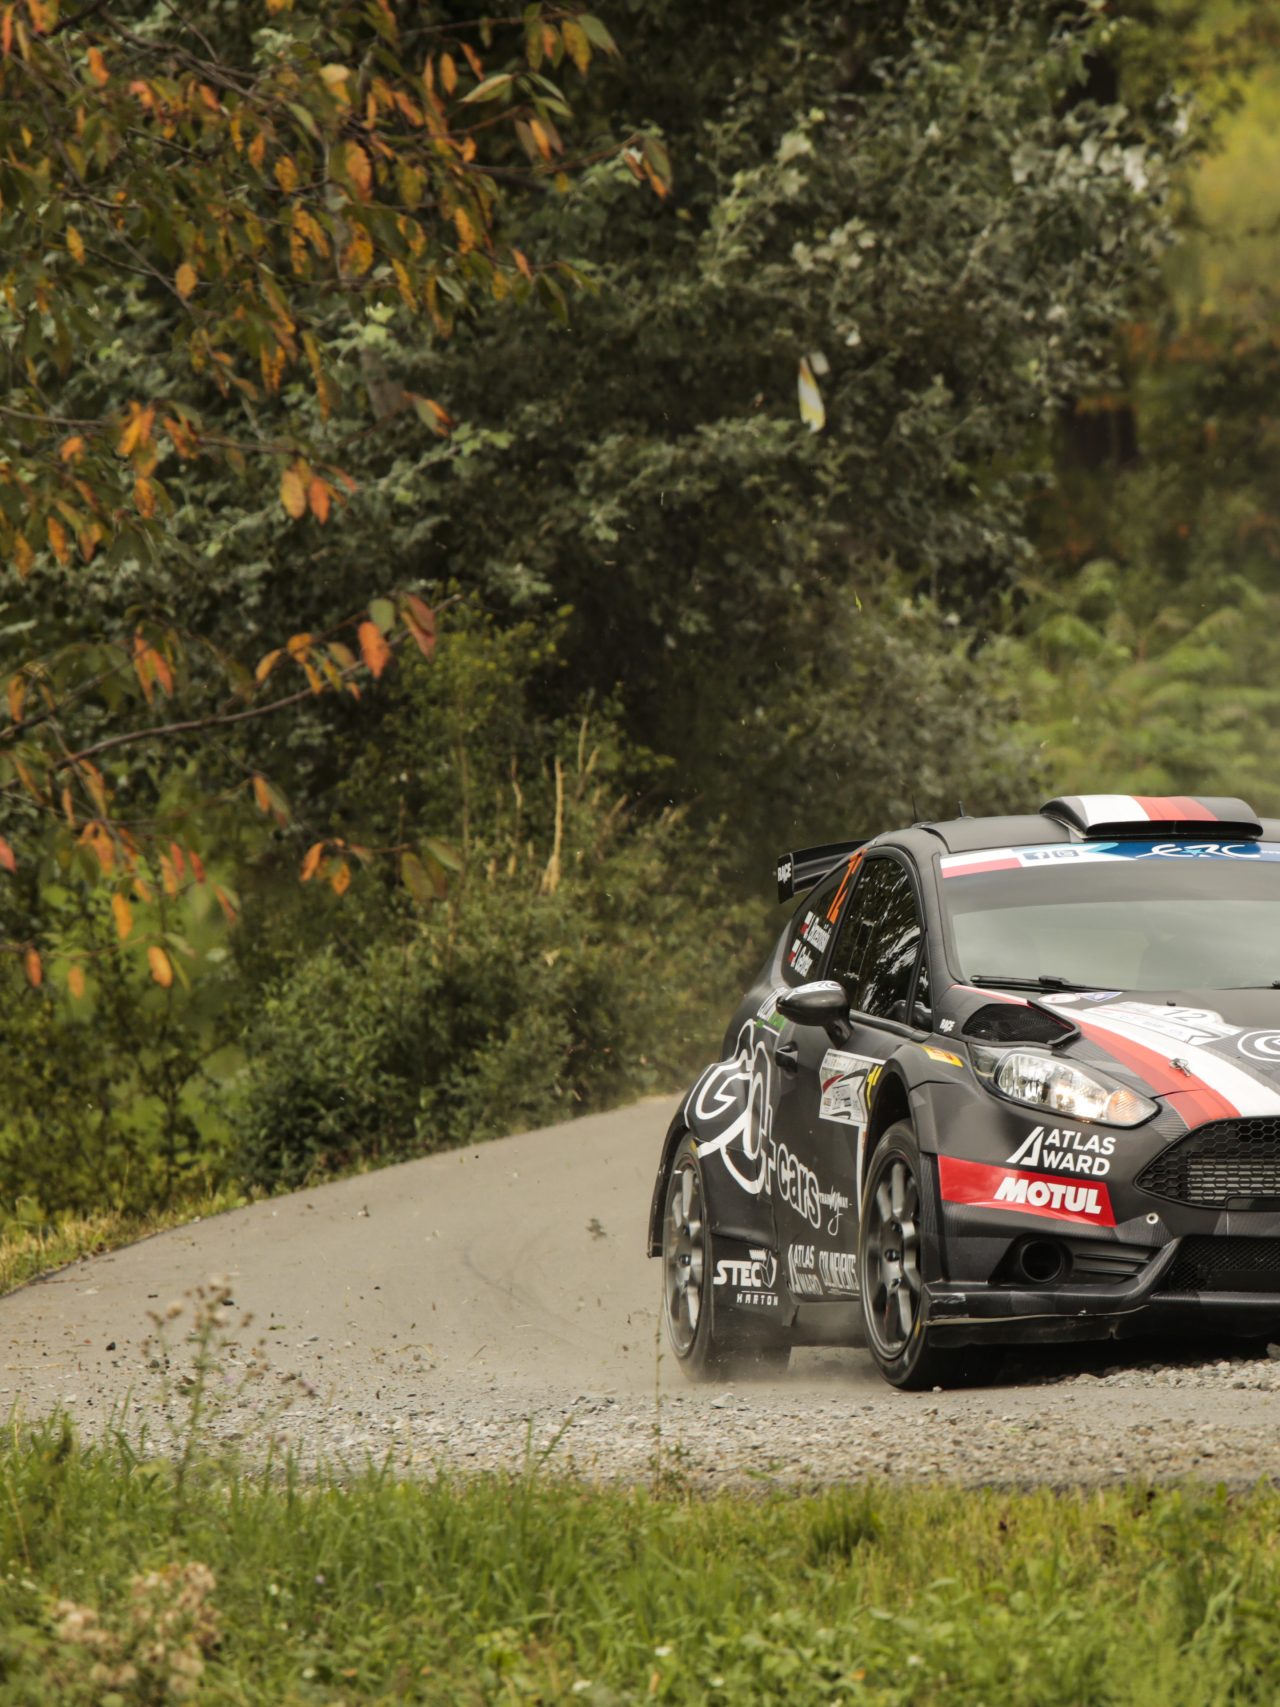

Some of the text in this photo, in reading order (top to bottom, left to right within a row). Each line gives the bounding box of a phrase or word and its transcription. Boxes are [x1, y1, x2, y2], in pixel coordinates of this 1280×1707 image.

[1044, 1128, 1117, 1155] ATLAS
[1042, 1149, 1111, 1176] WARD
[993, 1176, 1102, 1215] MOTUL
[793, 1245, 816, 1270] ATLAS
[713, 1259, 762, 1288] STEC
